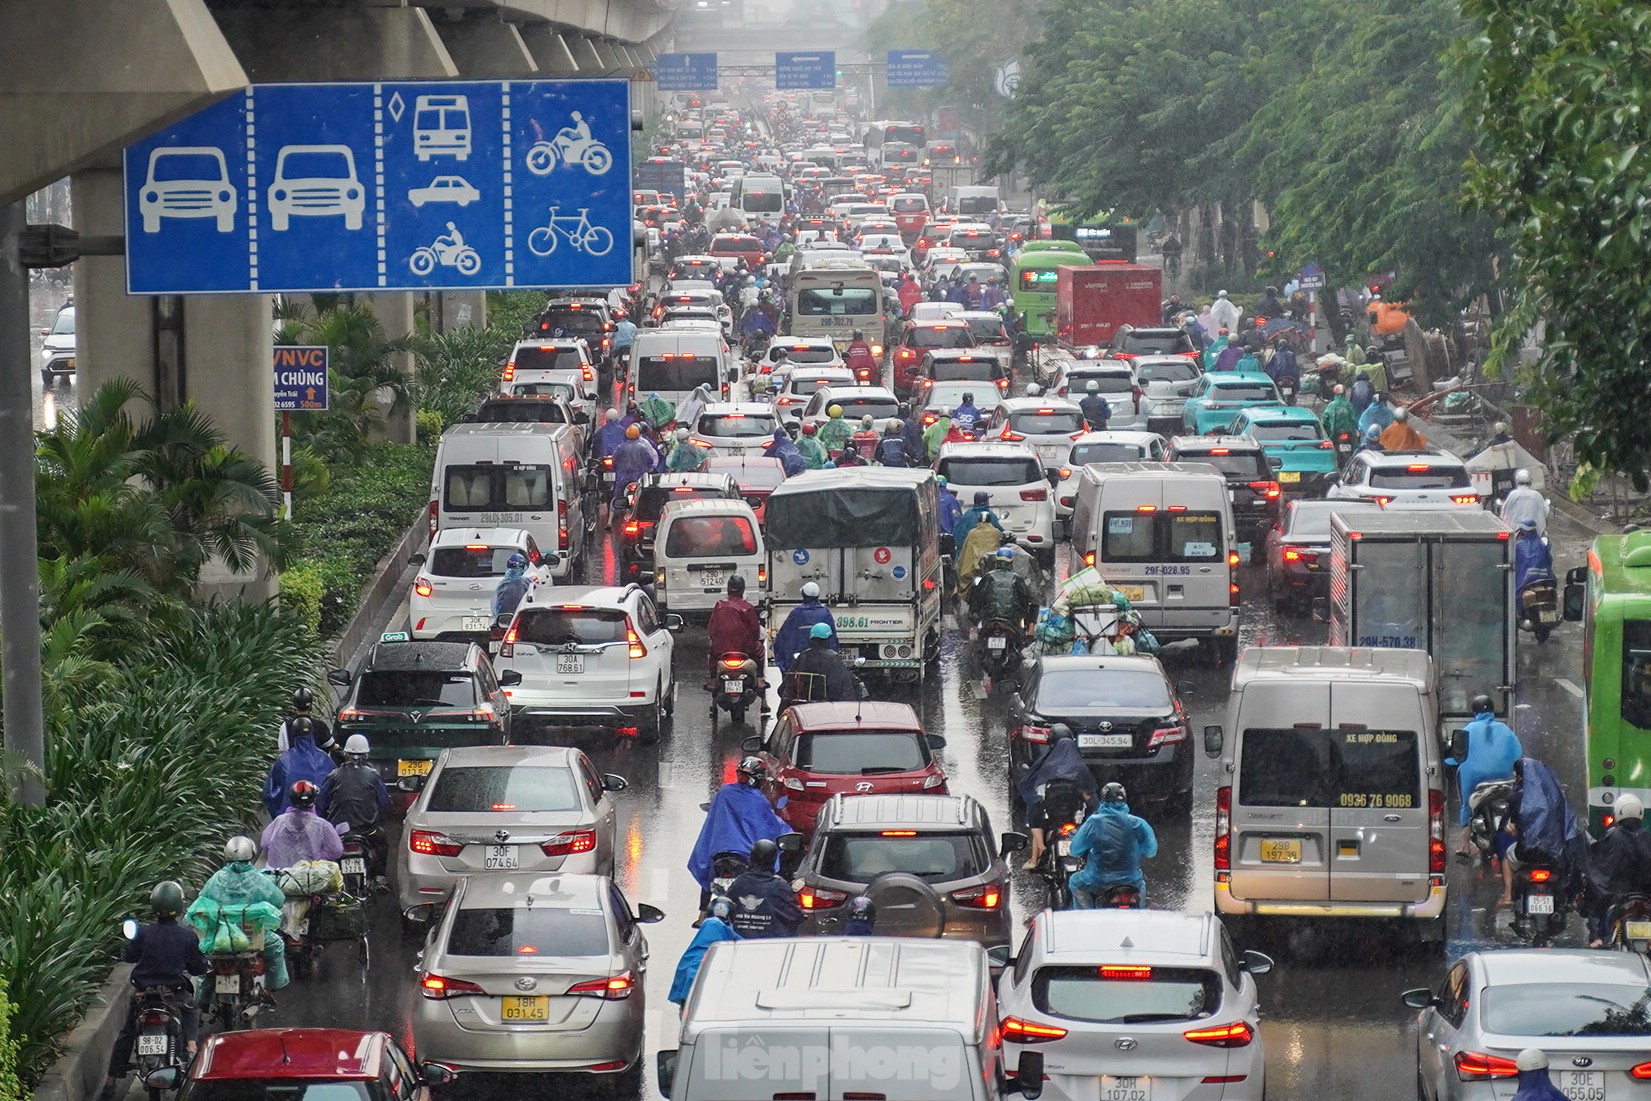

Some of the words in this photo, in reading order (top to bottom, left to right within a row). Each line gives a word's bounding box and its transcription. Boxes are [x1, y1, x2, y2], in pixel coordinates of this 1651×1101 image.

[281, 369, 324, 385] CHỦNG
[1145, 566, 1191, 575] 29F-028.95
[385, 633, 404, 641] Grab
[563, 655, 578, 663] 30A
[1083, 737, 1128, 745] 30L-345.94
[1346, 734, 1357, 743] XE
[1358, 733, 1375, 745] HỢP
[408, 761, 423, 769] 29G
[1340, 793, 1367, 807] 0936
[1369, 794, 1383, 807] 76
[1385, 794, 1412, 808] 9068
[1272, 841, 1290, 851] 29B
[493, 847, 510, 857] 30F
[486, 858, 518, 868] 074.64
[516, 998, 536, 1007] 18H
[507, 1008, 544, 1018] 031.45
[1115, 1078, 1137, 1089] 30H
[1570, 1072, 1594, 1086] 30E
[1107, 1089, 1146, 1101] 107.02
